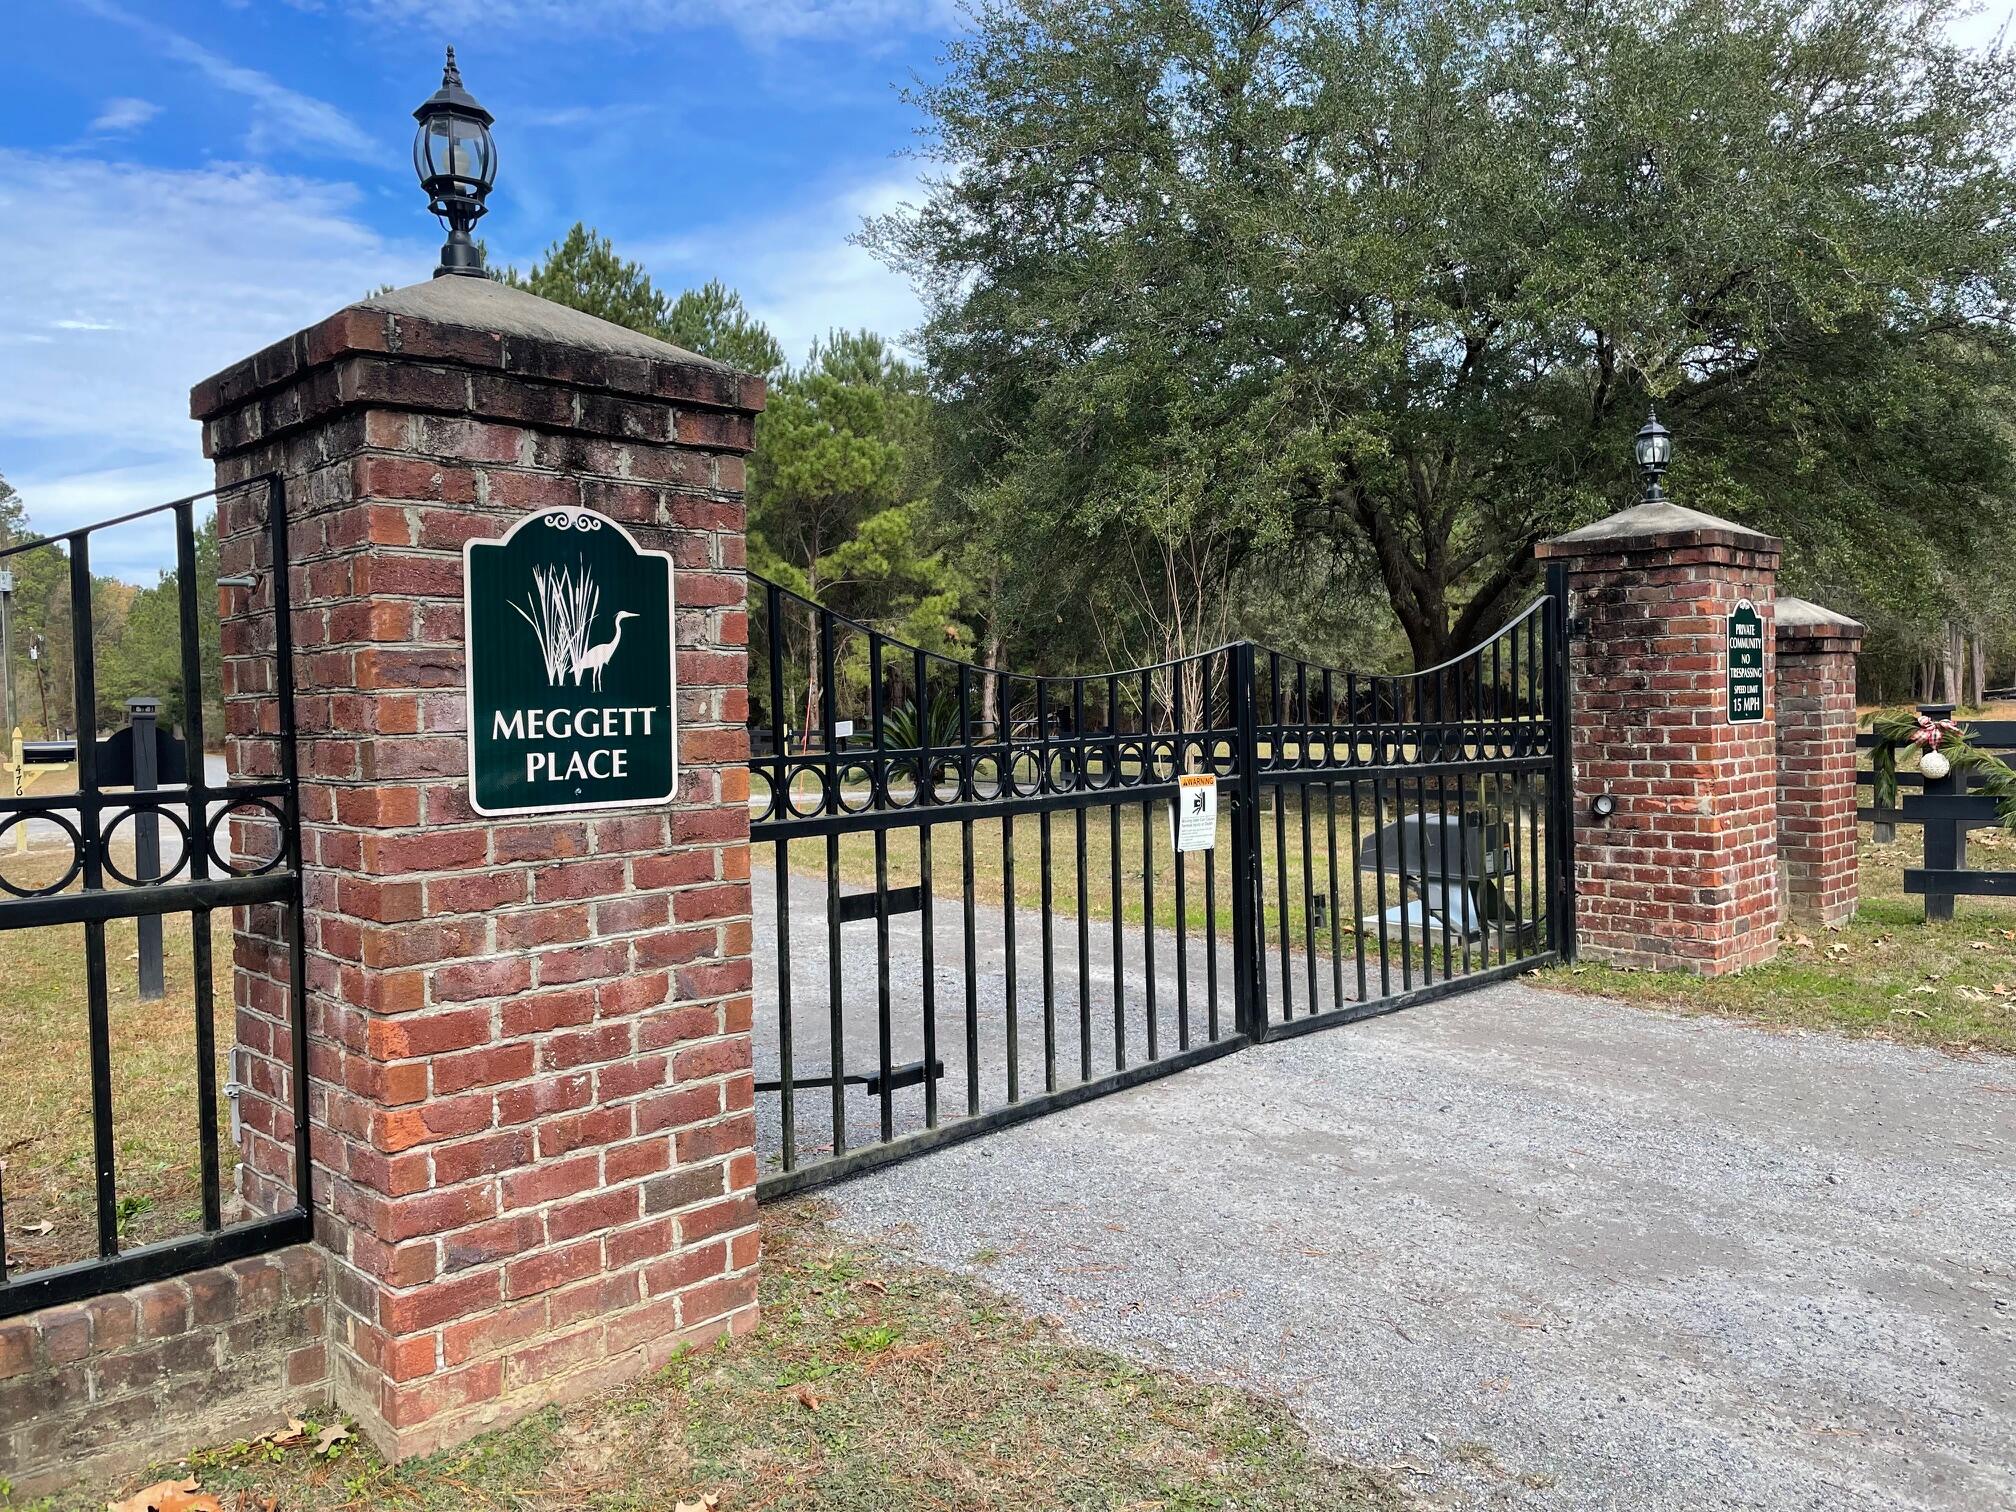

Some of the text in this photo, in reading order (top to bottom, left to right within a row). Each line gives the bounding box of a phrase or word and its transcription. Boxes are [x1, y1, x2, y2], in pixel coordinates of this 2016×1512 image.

[1735, 623, 1755, 636] PRIVATE
[1729, 637, 1762, 649] COMMUNITY
[1741, 653, 1751, 665] NO
[1730, 667, 1762, 678] TRESPASSING
[1733, 684, 1759, 694] SPEED LIMIT
[1733, 697, 1760, 712] 15 MPH
[492, 707, 656, 740] MEGGETT
[526, 749, 628, 782] PLACE
[1187, 777, 1213, 785] WARNING
